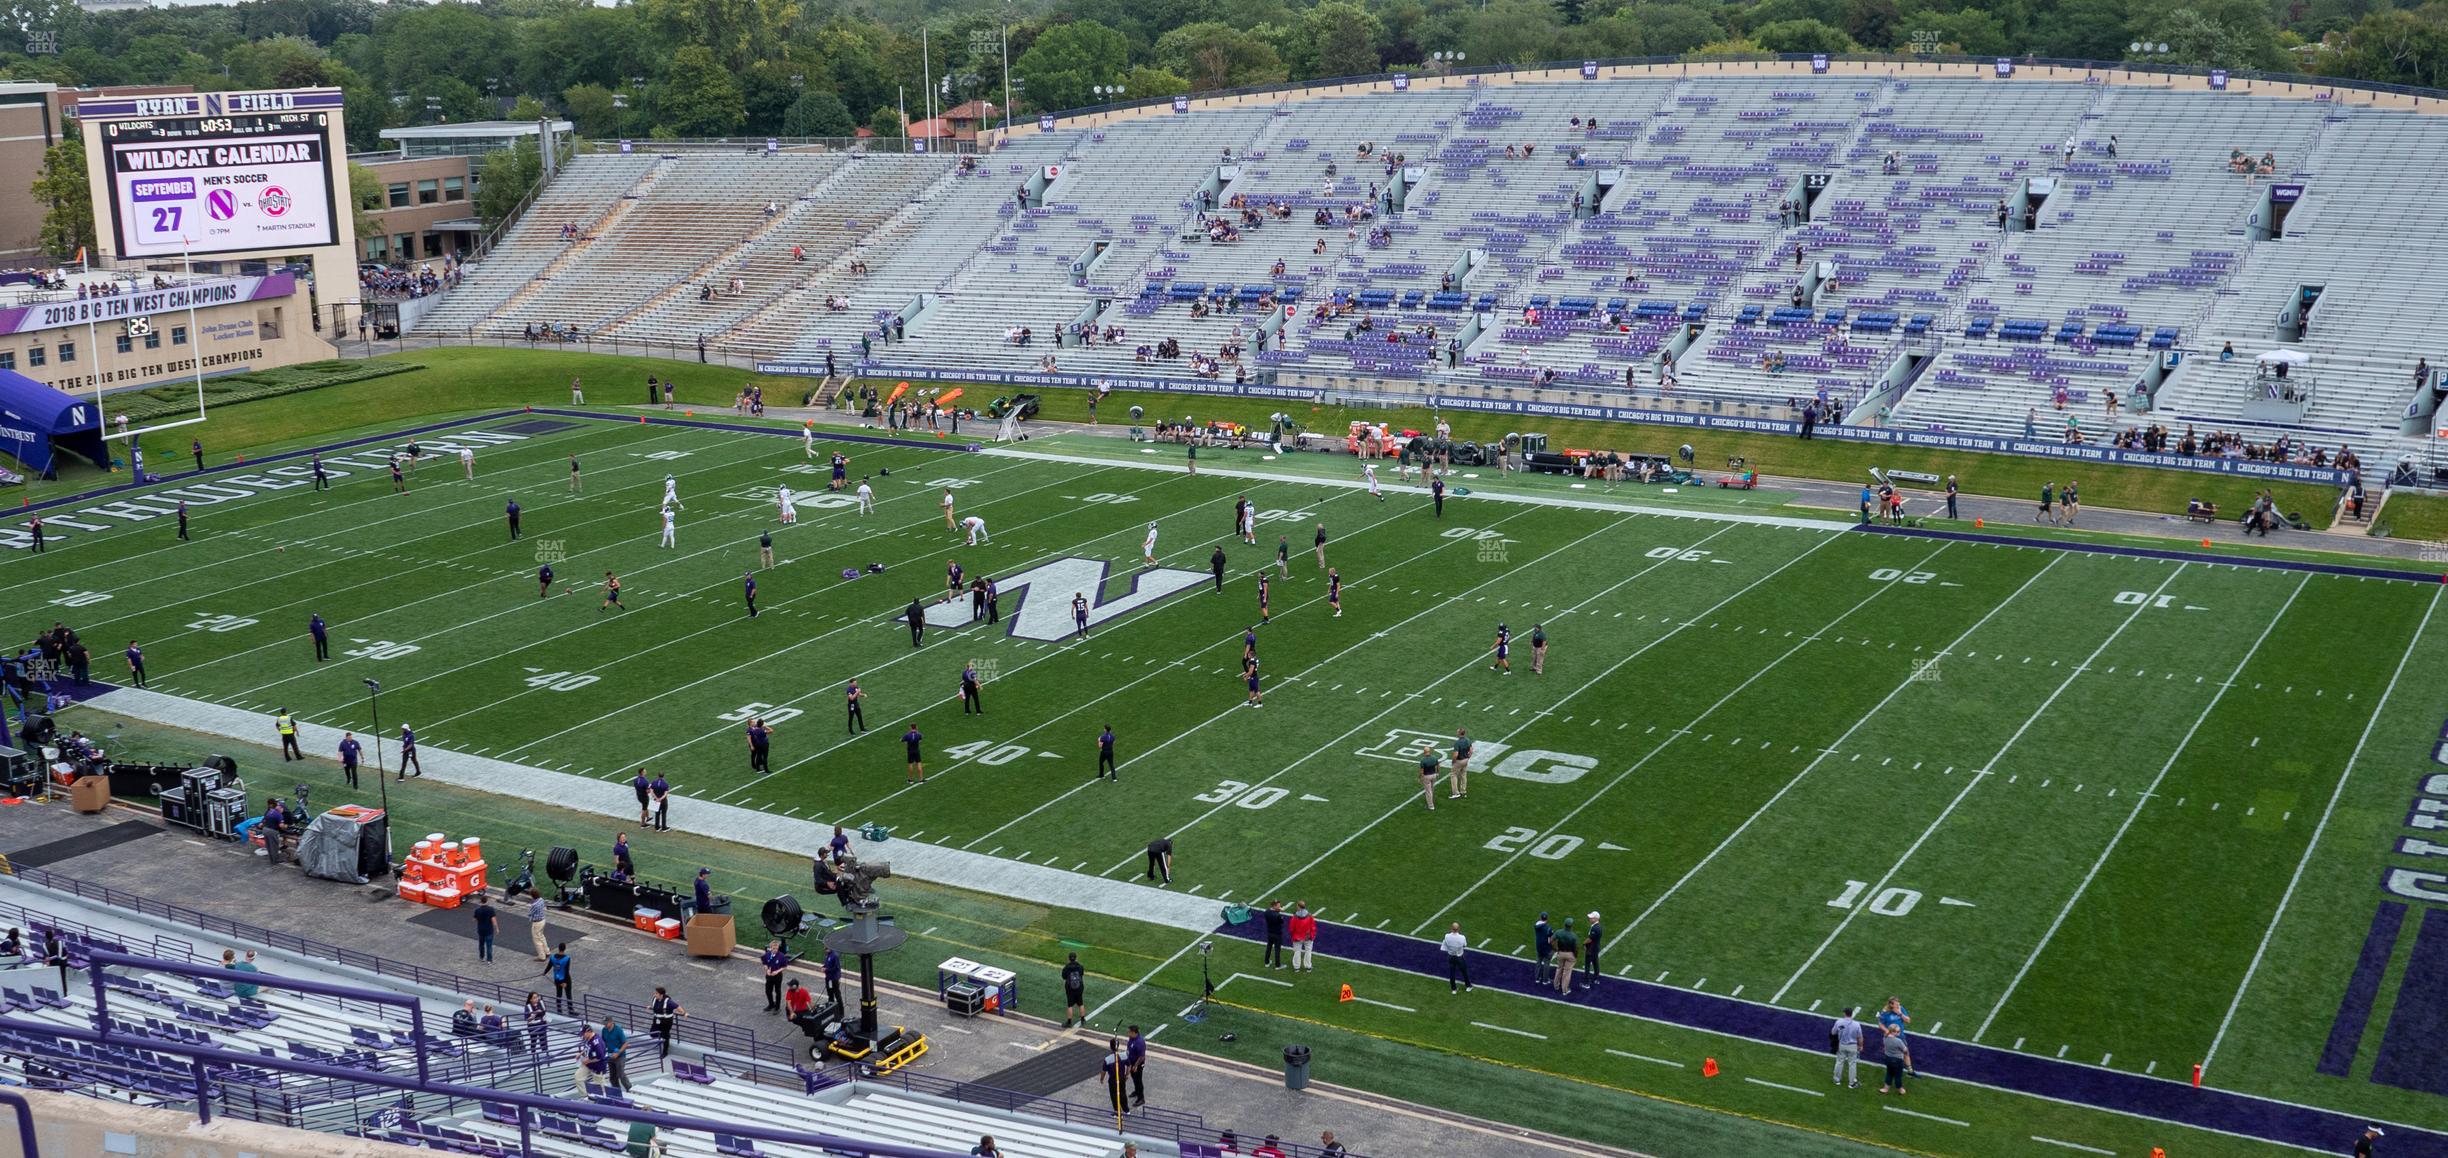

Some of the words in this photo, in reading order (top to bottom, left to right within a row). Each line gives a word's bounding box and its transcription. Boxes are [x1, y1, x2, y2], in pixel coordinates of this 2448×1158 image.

[1585, 66, 1596, 74] 107
[1814, 60, 1826, 68] 108
[1998, 63, 2010, 72] 109
[2213, 76, 2224, 84] 110
[136, 98, 188, 117] RYAN
[204, 94, 222, 117] N
[240, 94, 295, 111] FIELD
[109, 124, 118, 136] 0
[118, 120, 154, 130] WILDCATS
[201, 118, 232, 133] 60:53
[280, 114, 299, 123] MICH
[319, 114, 327, 126] 0
[126, 148, 210, 170] WILDCAT
[214, 143, 311, 166] CALENDAR
[203, 176, 231, 186] MEN'S
[234, 174, 268, 184] SOCCER
[135, 182, 194, 196] SEPTEMBER
[152, 206, 182, 232] 27
[288, 222, 316, 230] STADIUM
[45, 305, 76, 325] 2018
[81, 302, 102, 319] BIG
[107, 298, 128, 316] TEN
[134, 294, 165, 312] WEST
[169, 284, 237, 307] CHAMPIONS
[130, 318, 149, 335] 25
[60, 378, 82, 390] THE
[118, 368, 137, 381] BIG
[141, 364, 164, 377] TEN
[168, 360, 198, 373] WEST
[202, 348, 263, 367] CHAMPIONS
[1440, 399, 1470, 407] CHICAGO'S
[1528, 404, 1558, 412] CHICAGO'S
[72, 406, 86, 426] N
[1618, 411, 1649, 420] CHICAGO'S
[1712, 418, 1744, 427] CHICAGO'S
[1772, 423, 1789, 431] TEAM
[1796, 424, 1802, 433] N
[1812, 426, 1842, 435] HICAGO'S
[1871, 431, 1889, 439] TEAM
[1896, 432, 1902, 441] N
[1909, 434, 1944, 444] CHICAGO'S
[1959, 438, 1972, 446] TEN
[1974, 440, 1993, 448] TEAM
[135, 451, 142, 462] N
[2000, 441, 2007, 450] N
[2014, 443, 2050, 453] CHICAGO'S
[2065, 448, 2080, 456] TEN
[2082, 449, 2102, 458] TEAM
[2109, 451, 2116, 460] N
[2123, 453, 2161, 464] CHICAGO'S
[2163, 456, 2175, 465] BIG
[2178, 458, 2192, 466] TEN
[2194, 459, 2215, 468] TEAM
[2223, 461, 2230, 470] N
[2238, 463, 2277, 475] CHICAGO'S
[2279, 467, 2292, 476] BIG
[2294, 469, 2310, 478] TEN
[2312, 470, 2333, 480] TEAM
[2341, 473, 2349, 482] N
[1255, 509, 1316, 522] 50
[1440, 527, 1504, 540] 40
[1644, 547, 1712, 561] 30
[1868, 568, 1937, 584] 20
[48, 591, 114, 607] 10
[1077, 602, 1085, 610] 15
[2113, 591, 2176, 608] 10
[185, 614, 259, 632] 20
[343, 640, 422, 660] 30
[524, 671, 602, 692] 40
[717, 702, 804, 727] 50
[942, 740, 1031, 766] 40
[1192, 780, 1290, 810] 30
[1483, 826, 1584, 860] 20
[470, 874, 480, 886] G
[1827, 880, 1923, 916] 10
[1342, 990, 1351, 998] 20
